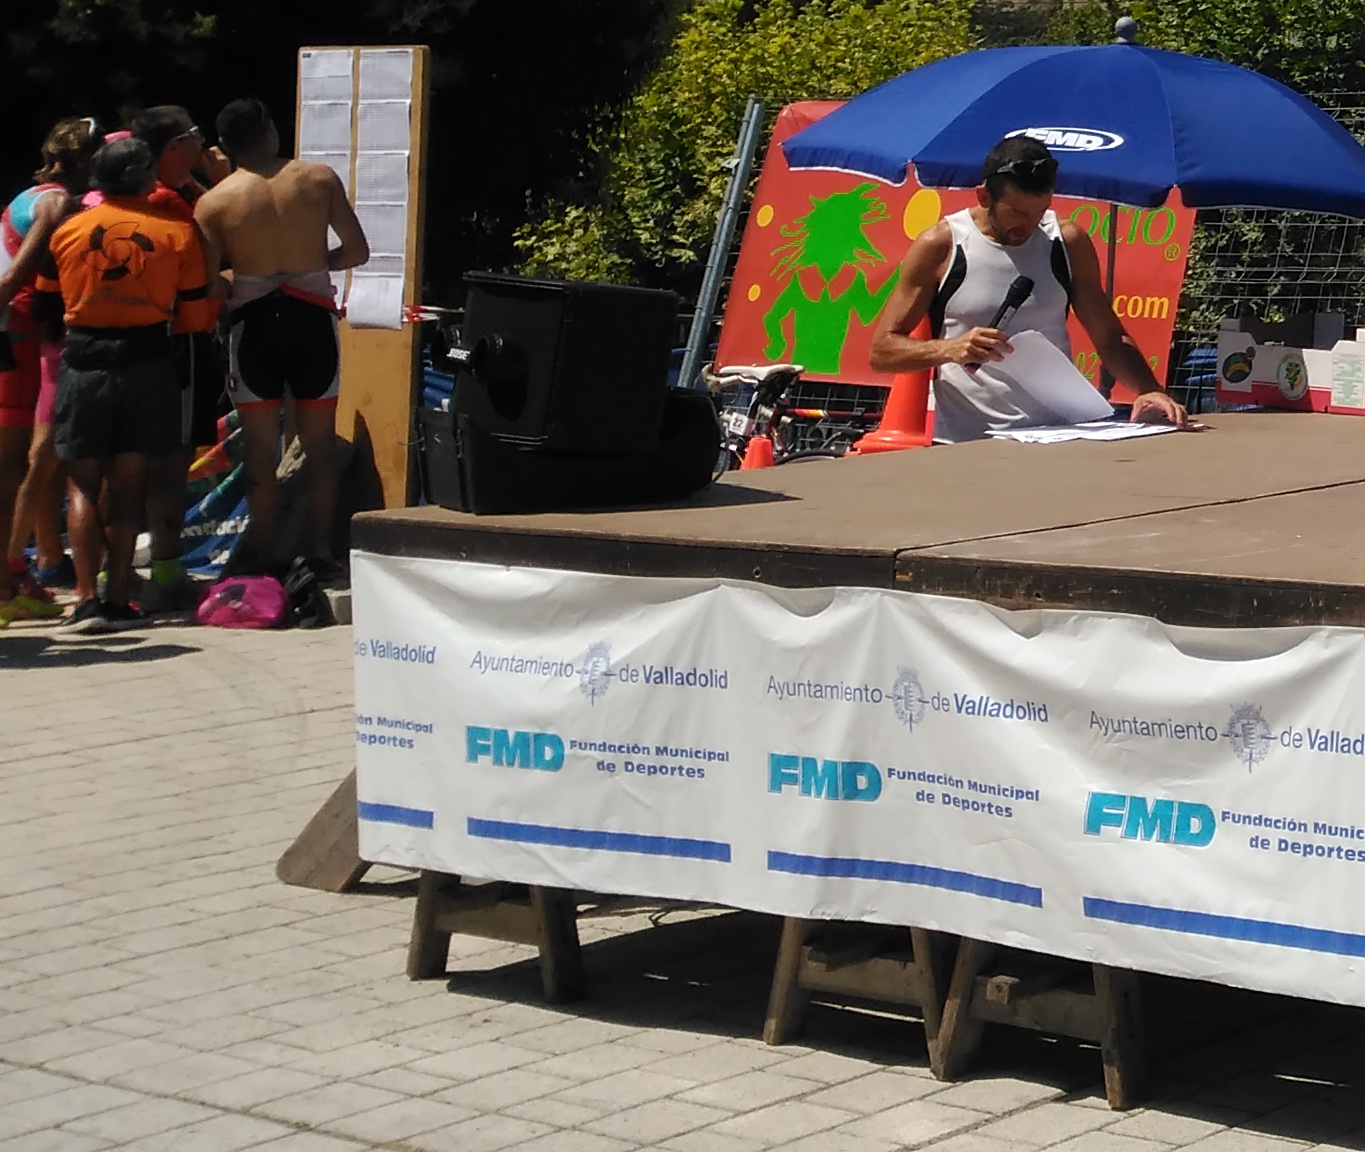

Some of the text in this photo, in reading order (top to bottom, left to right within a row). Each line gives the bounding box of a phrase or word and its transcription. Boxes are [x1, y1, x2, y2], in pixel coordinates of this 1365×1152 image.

[370, 639, 436, 664] Valladolid
[470, 651, 728, 689] Ayuntamiento de Valladolid
[767, 675, 1048, 722] Ayuntamiento de Valladolid
[377, 716, 432, 733] Municipal
[1089, 711, 1218, 741] Ayuntamiento
[1280, 727, 1302, 748] de
[466, 726, 565, 772] FMD
[570, 740, 729, 762] Fundación Municipal
[596, 760, 705, 779] de Deportes
[767, 752, 883, 802] FMD
[887, 768, 1039, 802] Fundación Municipal
[916, 790, 1013, 817] de Deportes
[1083, 791, 1216, 848] FMD
[1221, 811, 1308, 833] Fundación
[1249, 836, 1270, 850] de
